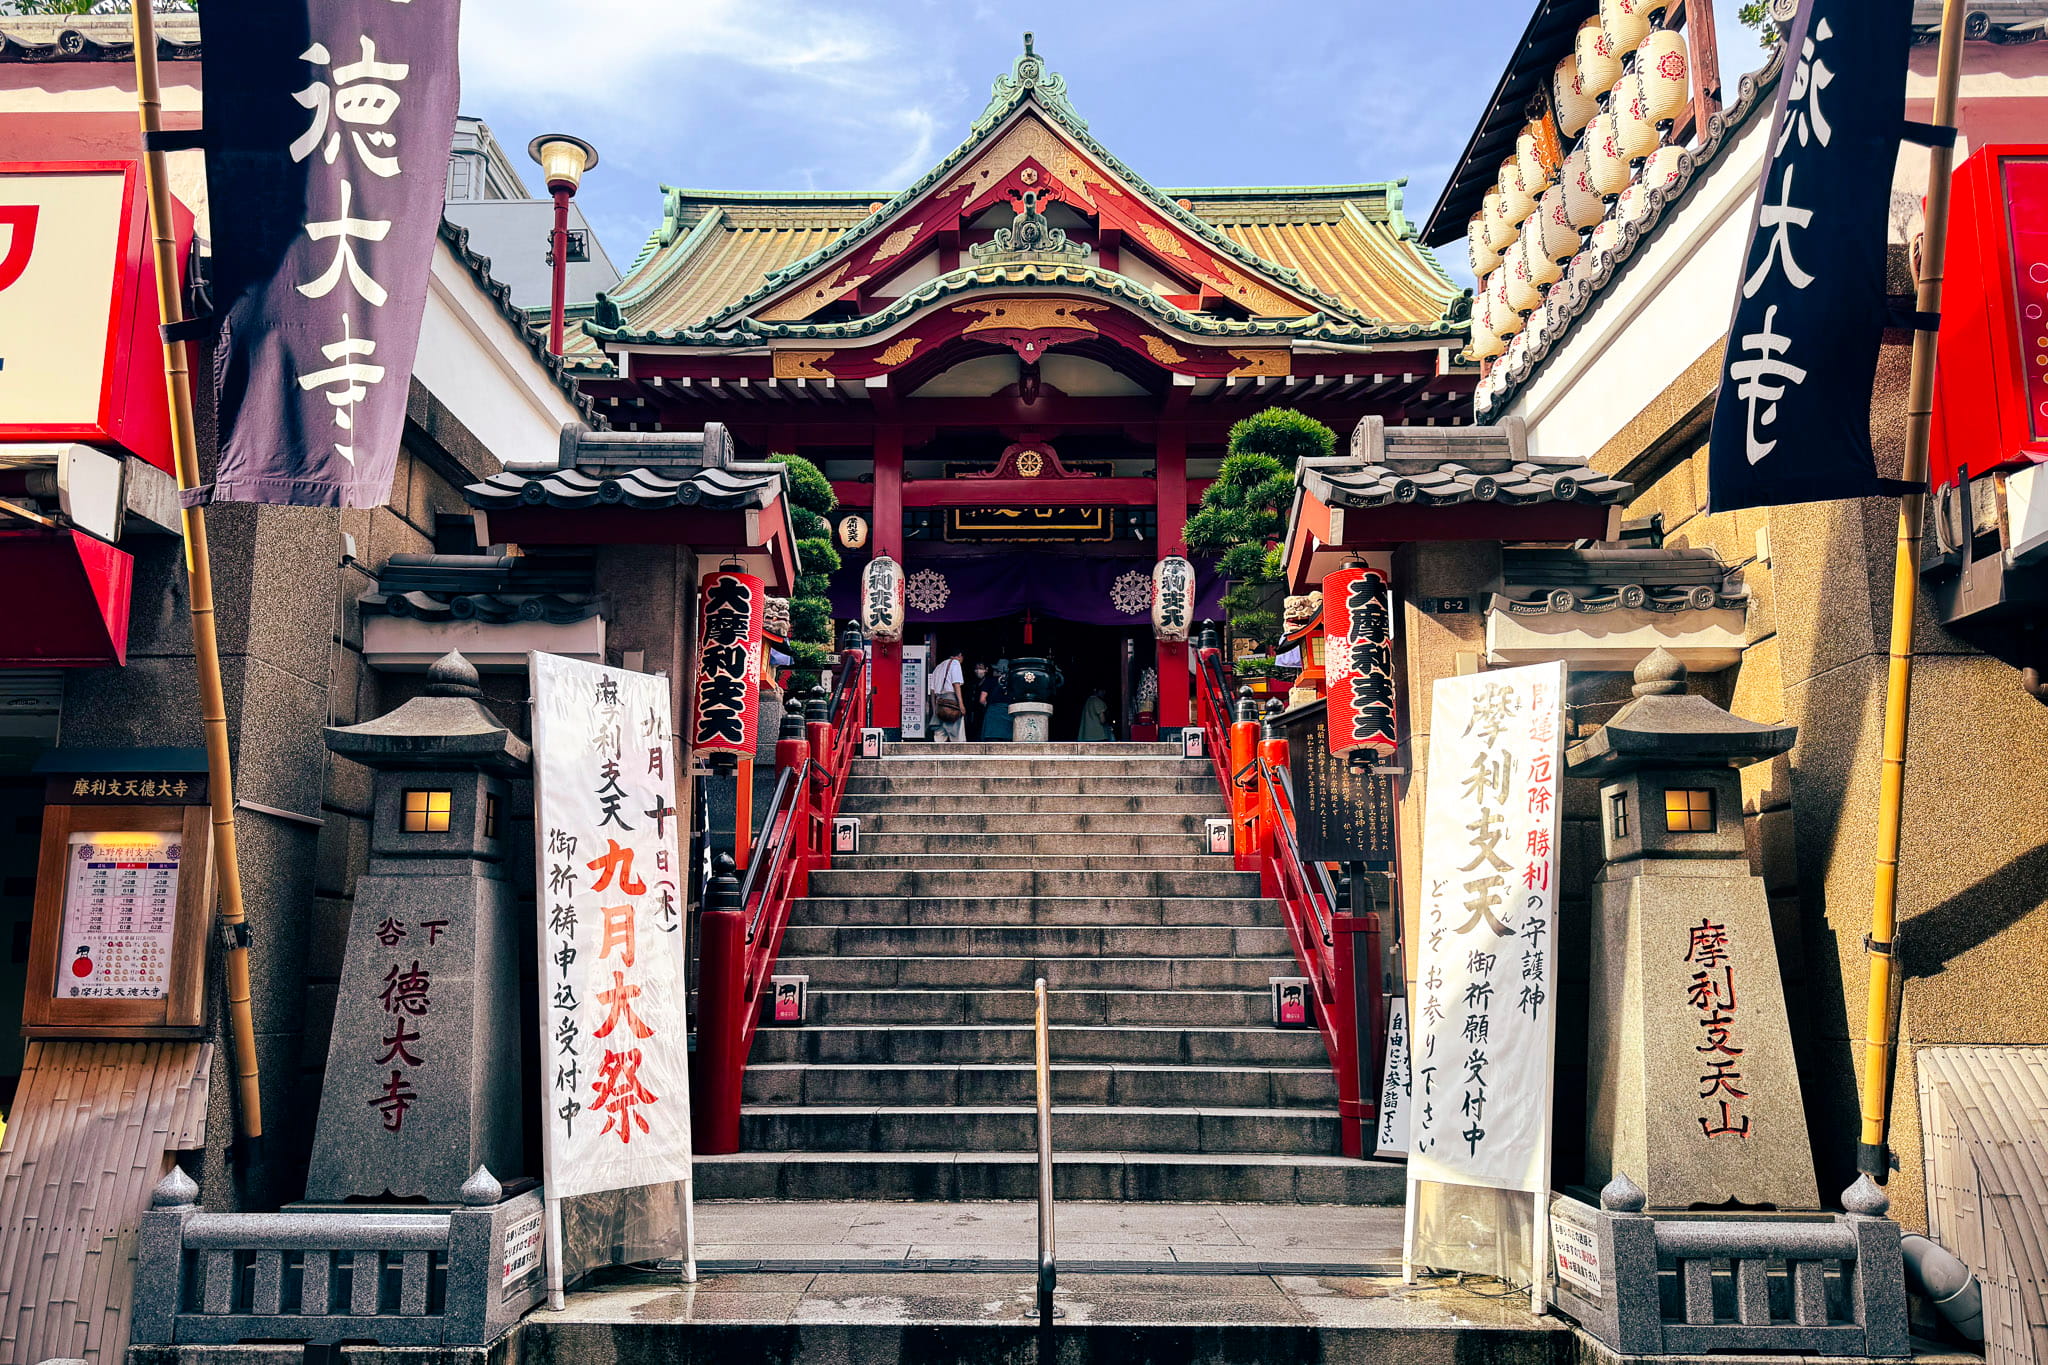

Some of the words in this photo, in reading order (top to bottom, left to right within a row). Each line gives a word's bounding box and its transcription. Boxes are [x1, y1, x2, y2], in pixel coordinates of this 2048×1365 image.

[696, 574, 752, 744] 大摩利支天
[1346, 571, 1398, 742] 大摩利支天
[1444, 600, 1464, 610] 6-2
[1684, 918, 1752, 1140] 摩利支天山
